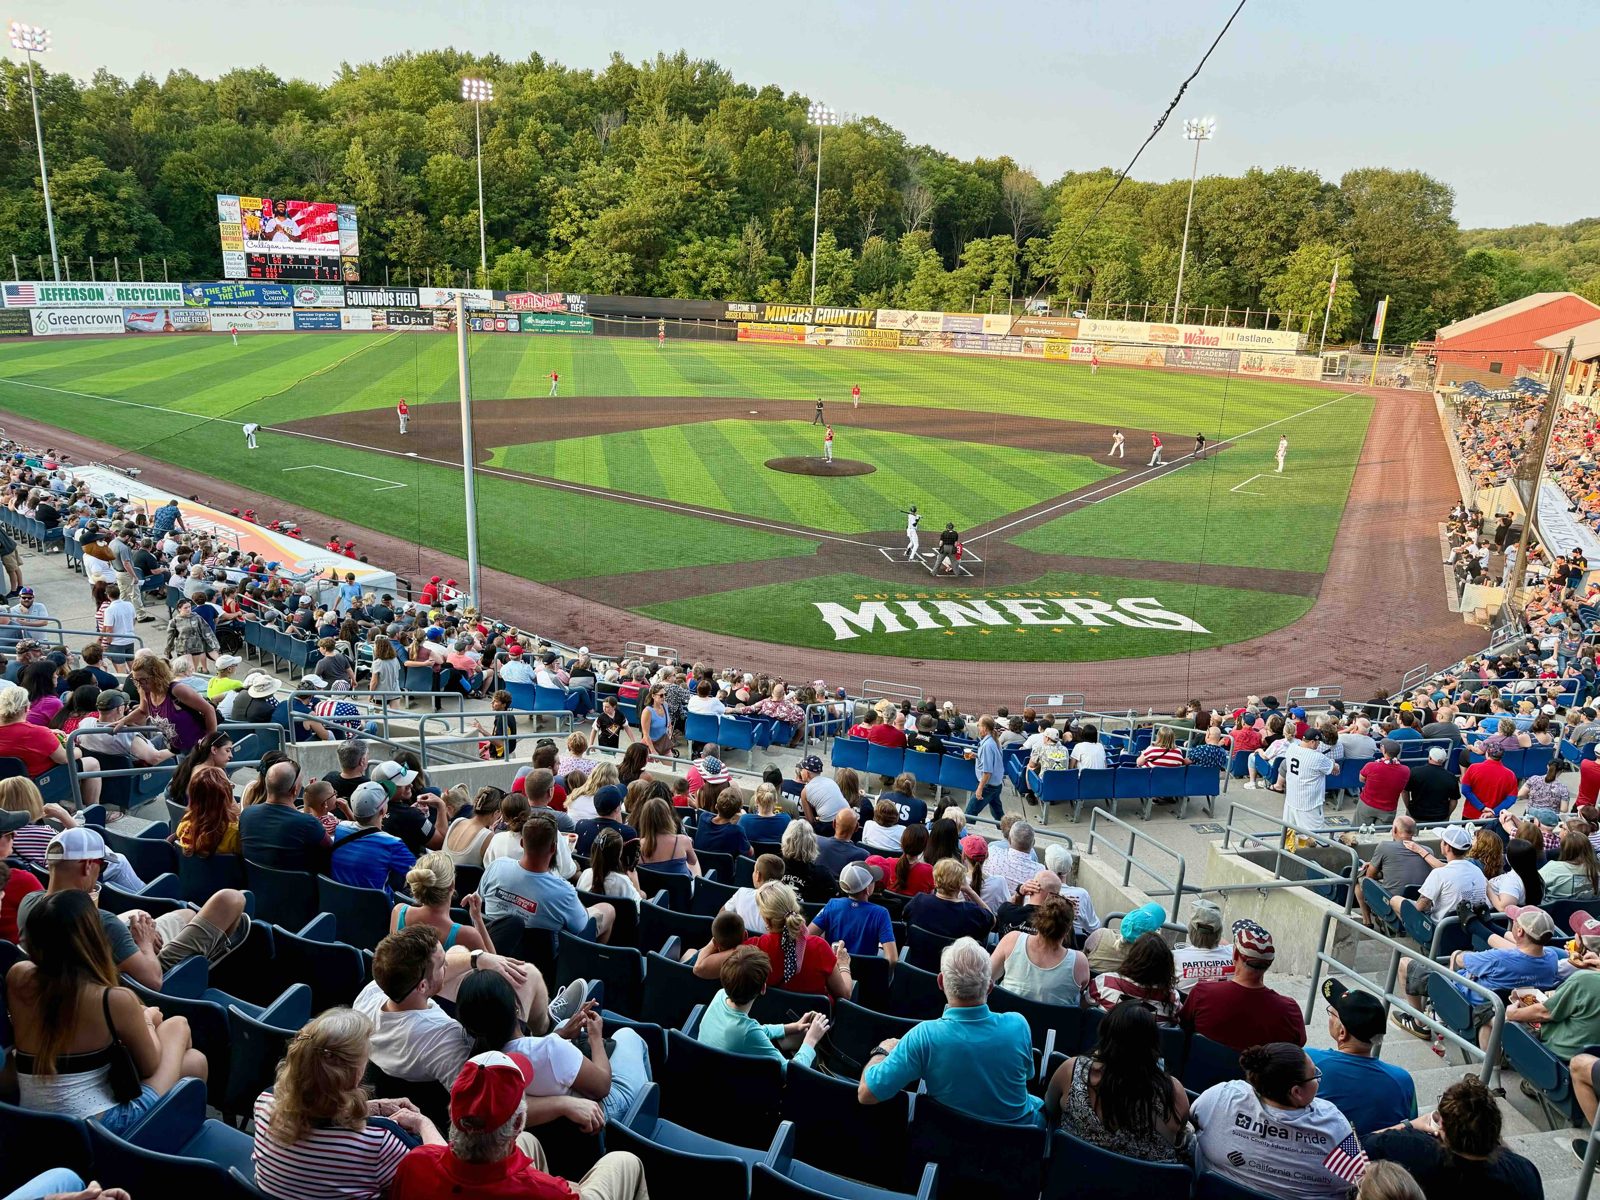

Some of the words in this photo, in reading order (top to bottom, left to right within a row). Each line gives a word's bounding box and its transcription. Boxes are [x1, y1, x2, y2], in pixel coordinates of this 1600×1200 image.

[246, 240, 280, 250] Culligan
[39, 288, 104, 301] JEFFERSON
[116, 288, 180, 301] RECYCLING
[236, 290, 255, 298] LIMIT
[347, 292, 394, 306] COLUMBUS
[396, 292, 418, 306] FIELD
[567, 294, 580, 303] NOV
[48, 312, 122, 325] Greencrown
[742, 312, 759, 320] COUNTY
[764, 305, 813, 323] MINERS
[815, 308, 872, 326] COUNTRY
[847, 329, 868, 337] INDOOR
[870, 329, 898, 338] TRAINING
[1183, 332, 1220, 346] Wawa
[846, 337, 874, 346] SKYLANDS
[812, 597, 1213, 641] MINERS
[1291, 758, 1300, 775] 2
[1182, 960, 1233, 968] PARTICIPAN
[1186, 968, 1223, 978] GASSER
[1253, 1120, 1289, 1139] njea
[1296, 1131, 1327, 1145] Pride
[1251, 1136, 1270, 1148] County
[1248, 1160, 1291, 1177] California
[1293, 1171, 1332, 1185] Casualty
